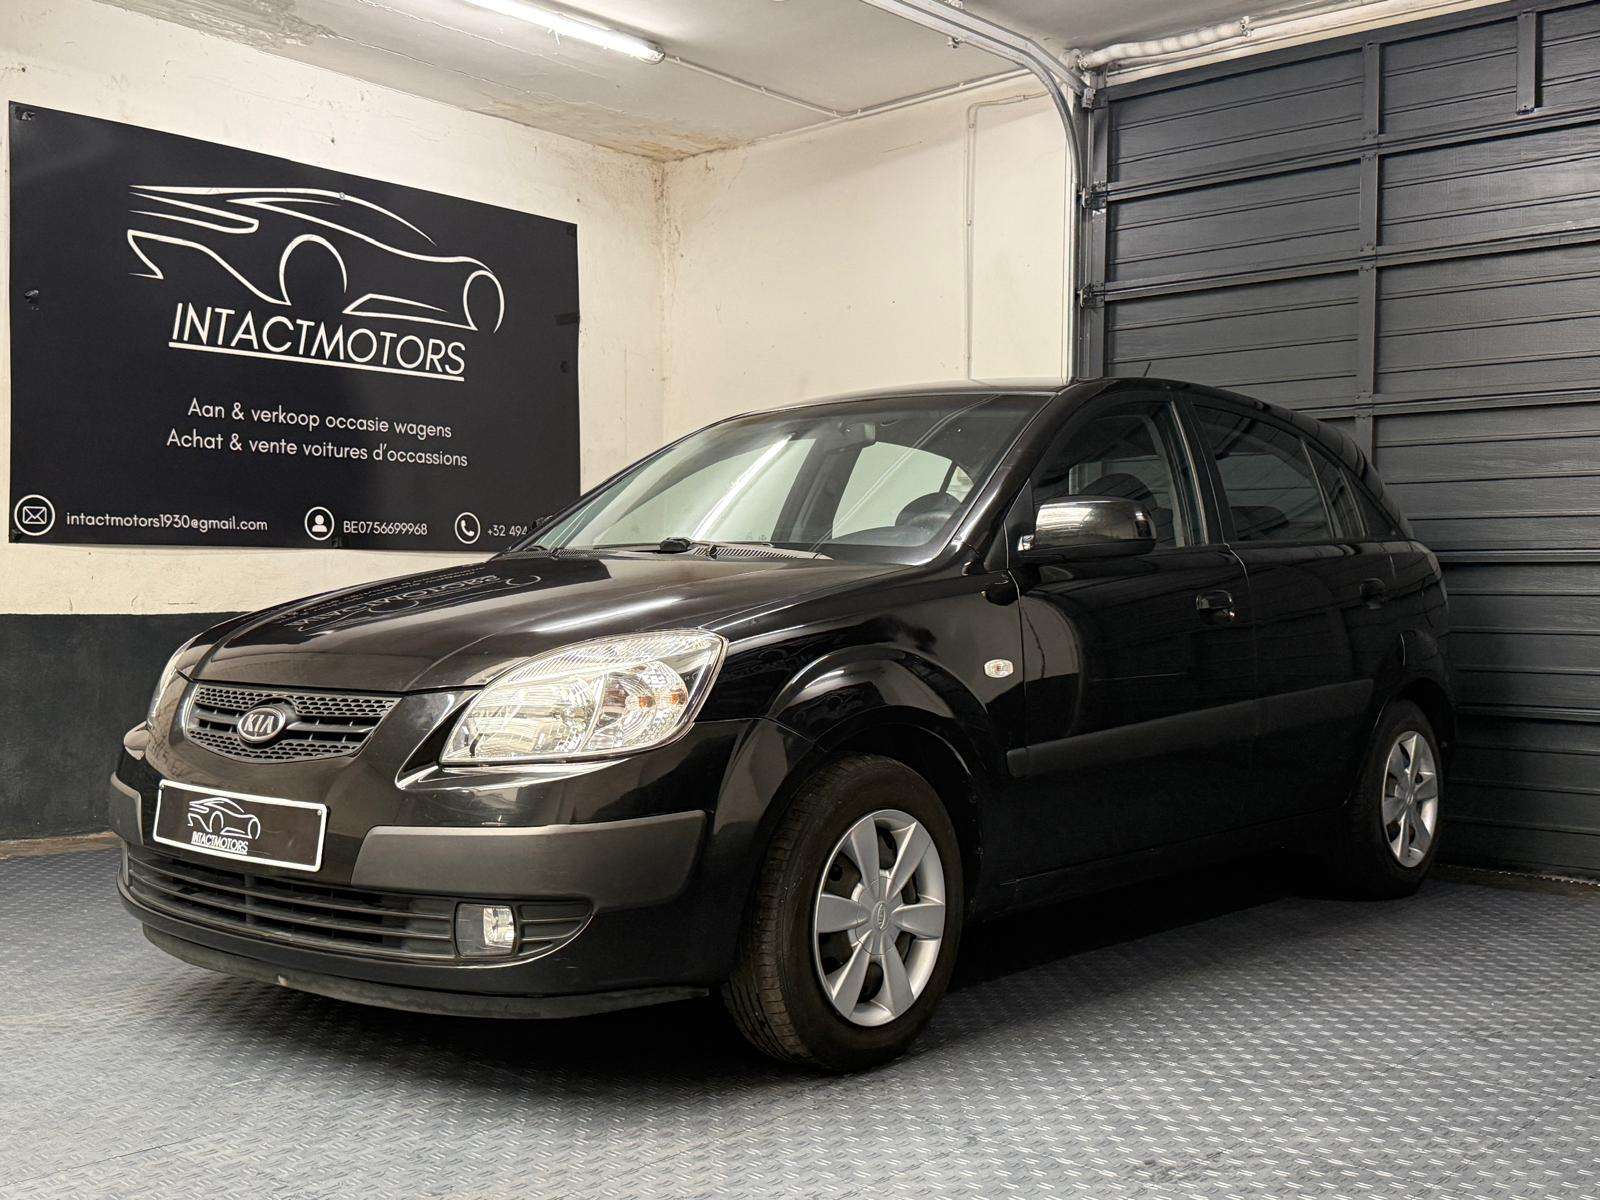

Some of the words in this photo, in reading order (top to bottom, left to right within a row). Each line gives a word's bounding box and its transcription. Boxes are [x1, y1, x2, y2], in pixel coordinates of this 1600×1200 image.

[172, 302, 466, 375] INTACTMOTORS
[187, 397, 225, 418] Aan
[231, 402, 245, 420] &
[251, 404, 320, 431] verkoop
[325, 415, 389, 432] occasie
[394, 421, 452, 440] wagens
[166, 428, 223, 449] Achat
[229, 433, 242, 451] &
[249, 438, 297, 455] vente
[302, 442, 368, 460] voitures
[66, 512, 268, 532] intactmotors1930@gmail.com
[343, 520, 428, 535] BE0756699968
[487, 524, 506, 537] +32
[243, 713, 275, 734] KIA
[191, 830, 249, 853] INTACTMOTORS
